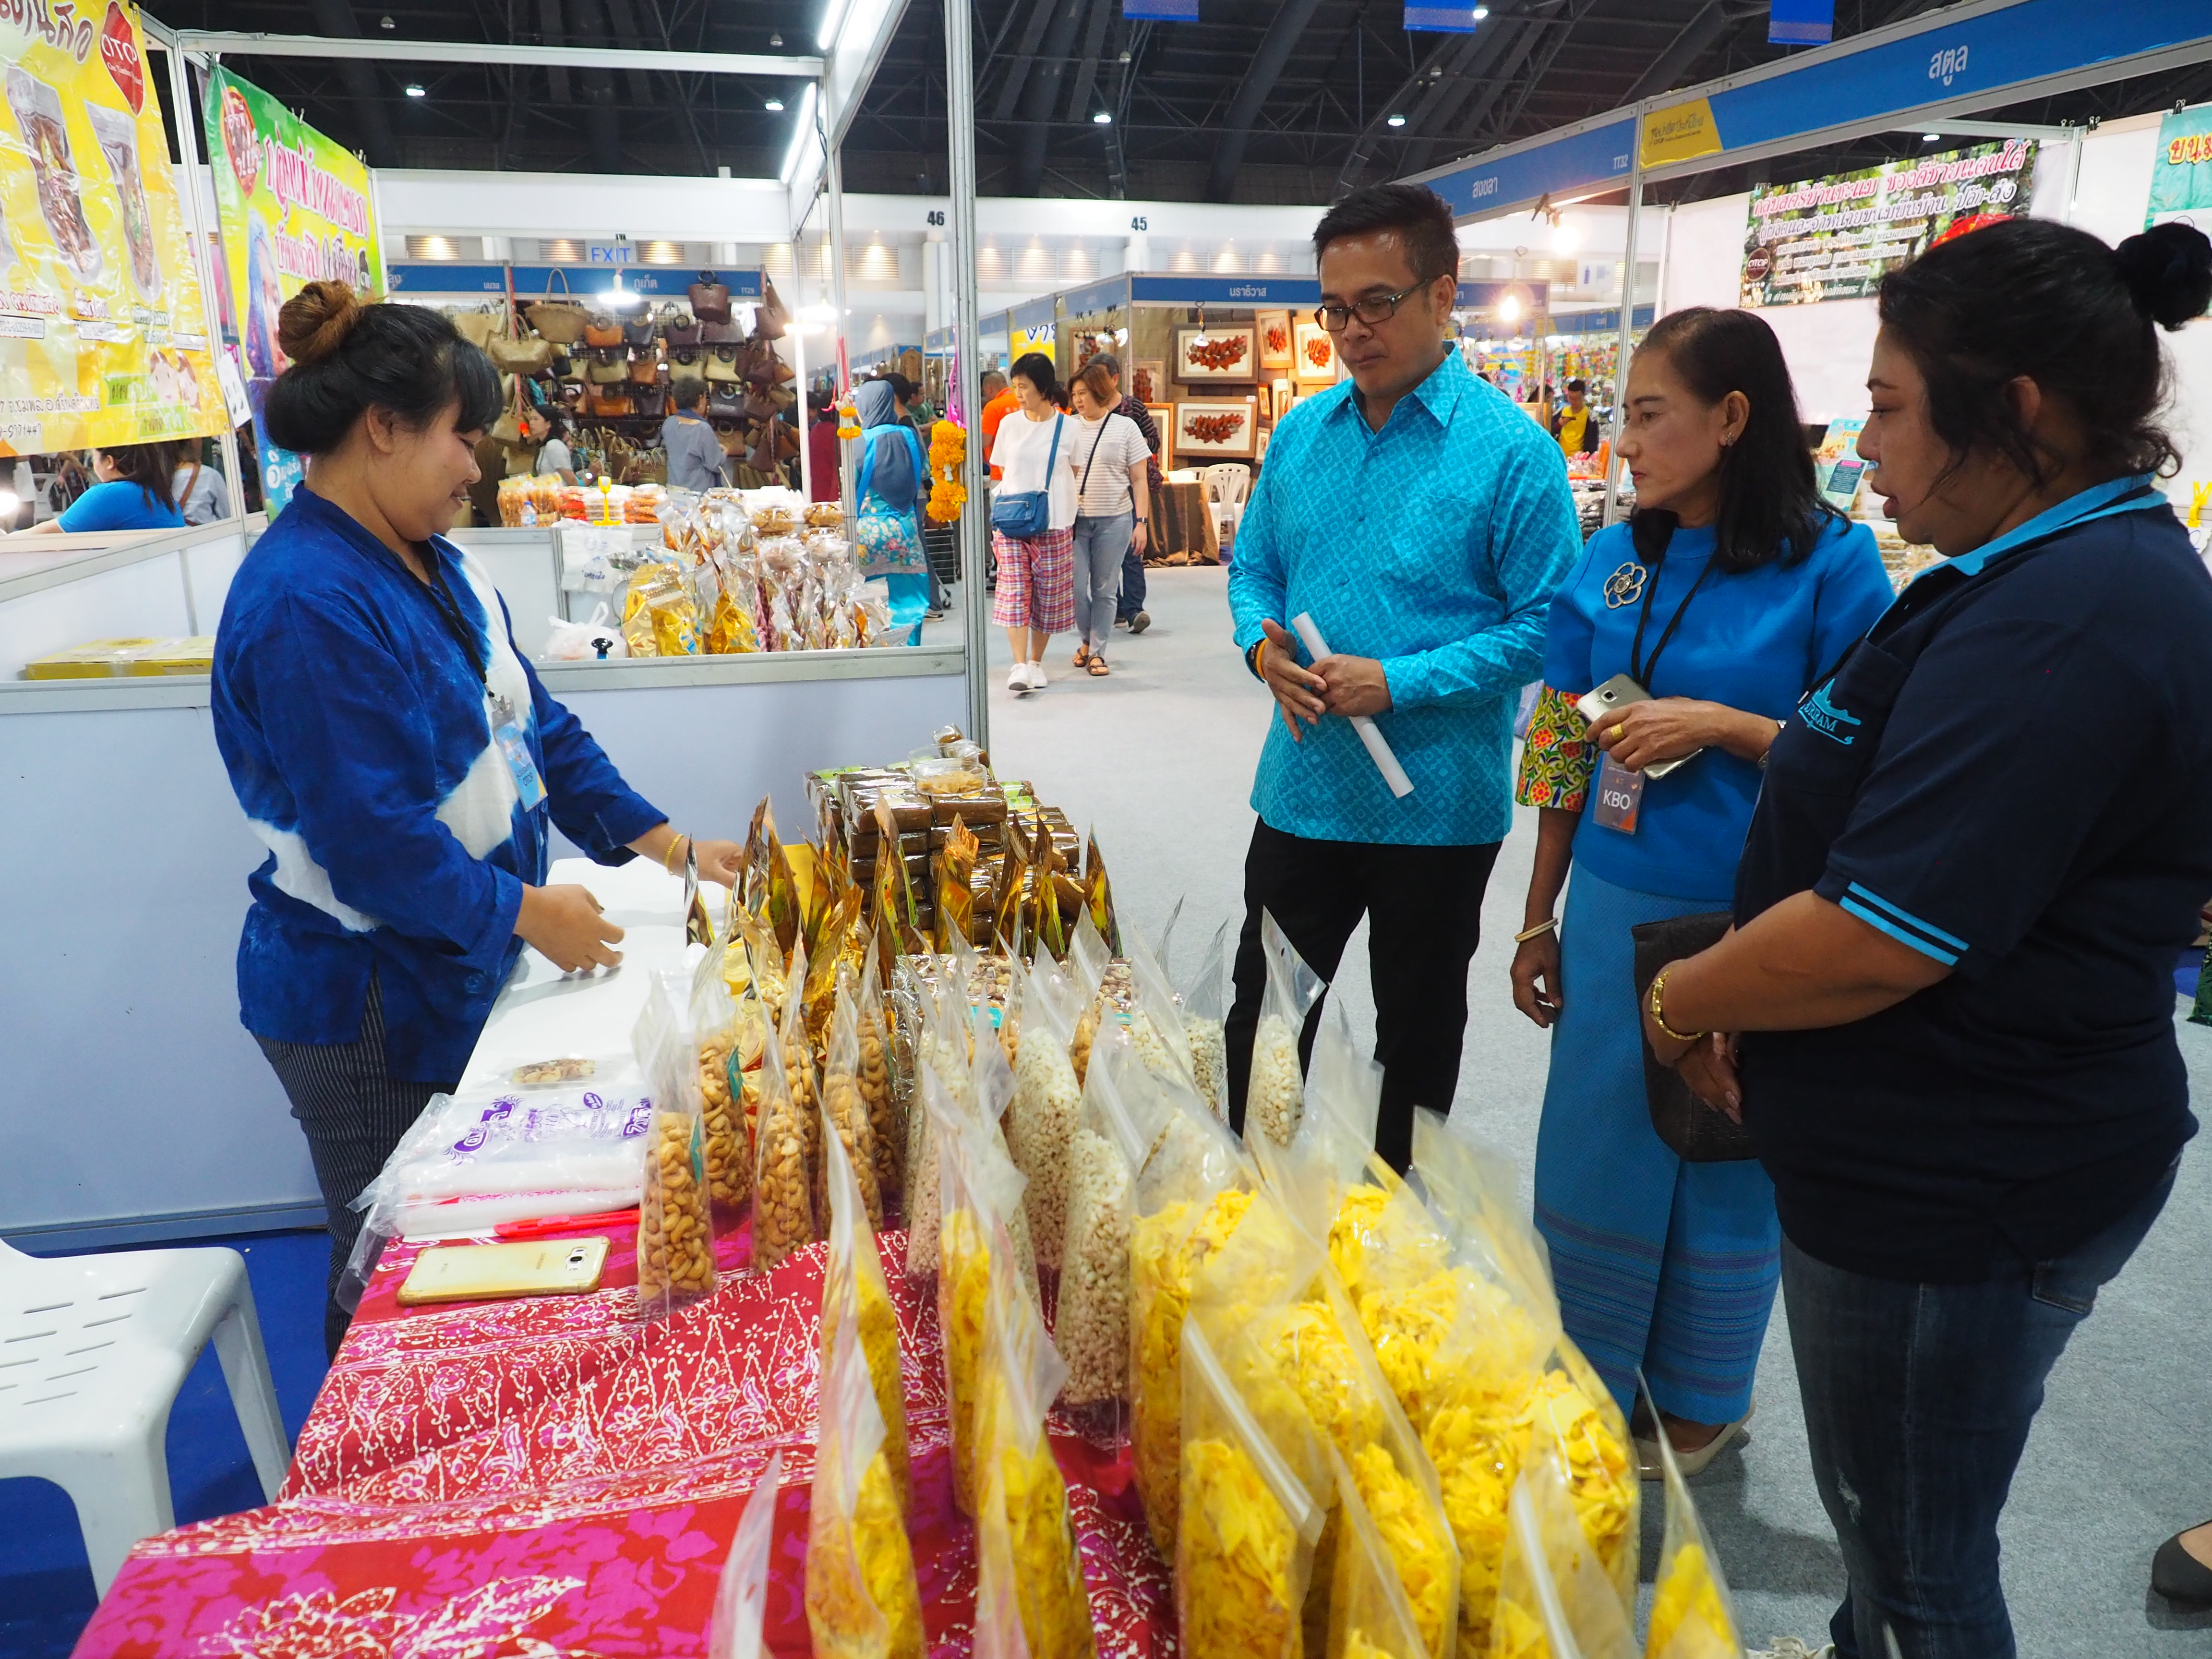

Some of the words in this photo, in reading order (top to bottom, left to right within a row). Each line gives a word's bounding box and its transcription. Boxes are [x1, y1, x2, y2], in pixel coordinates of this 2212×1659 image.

[1929, 45, 1969, 85] สตูล
[1613, 154, 1629, 169] TT32
[1887, 139, 2031, 191] ของดีชายแดนใต้
[1472, 177, 1498, 198] สงขลา
[1957, 179, 2016, 210] ปลีก-ส่ง
[927, 211, 945, 226] 46
[1132, 217, 1148, 231] 45
[591, 246, 631, 263] EXIT
[1748, 258, 1768, 268] OTOP
[1229, 285, 1267, 298] นราธิวาส
[1603, 789, 1630, 810] KBO
